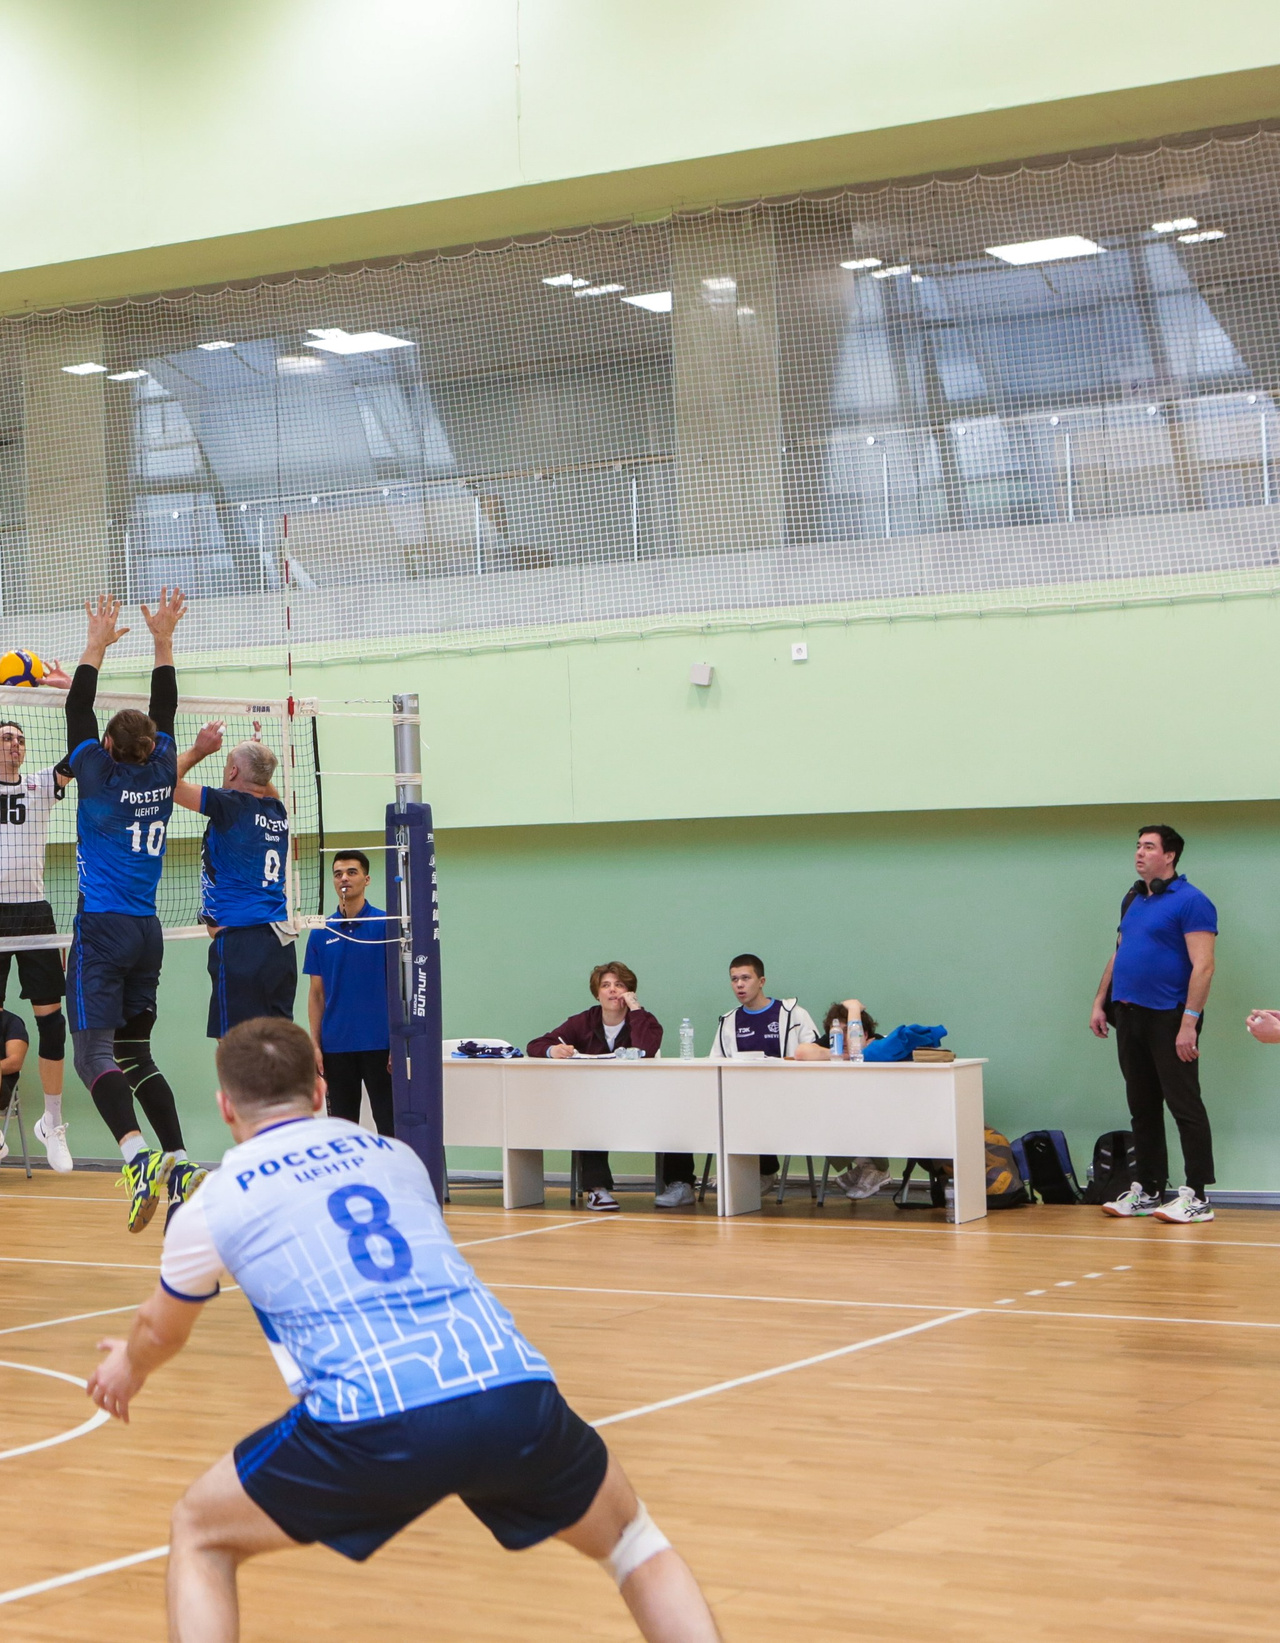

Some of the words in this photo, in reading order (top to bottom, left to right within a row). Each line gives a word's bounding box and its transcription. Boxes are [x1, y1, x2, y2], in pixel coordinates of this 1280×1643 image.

[120, 785, 172, 805] РОССЕТИ
[134, 806, 160, 818] ЦЕНТР
[125, 820, 166, 857] 10
[417, 967, 427, 1017] JINLING
[235, 1134, 395, 1193] РОССЕТИ
[293, 1155, 365, 1184] ЦЕНТР
[327, 1183, 413, 1284] 8
